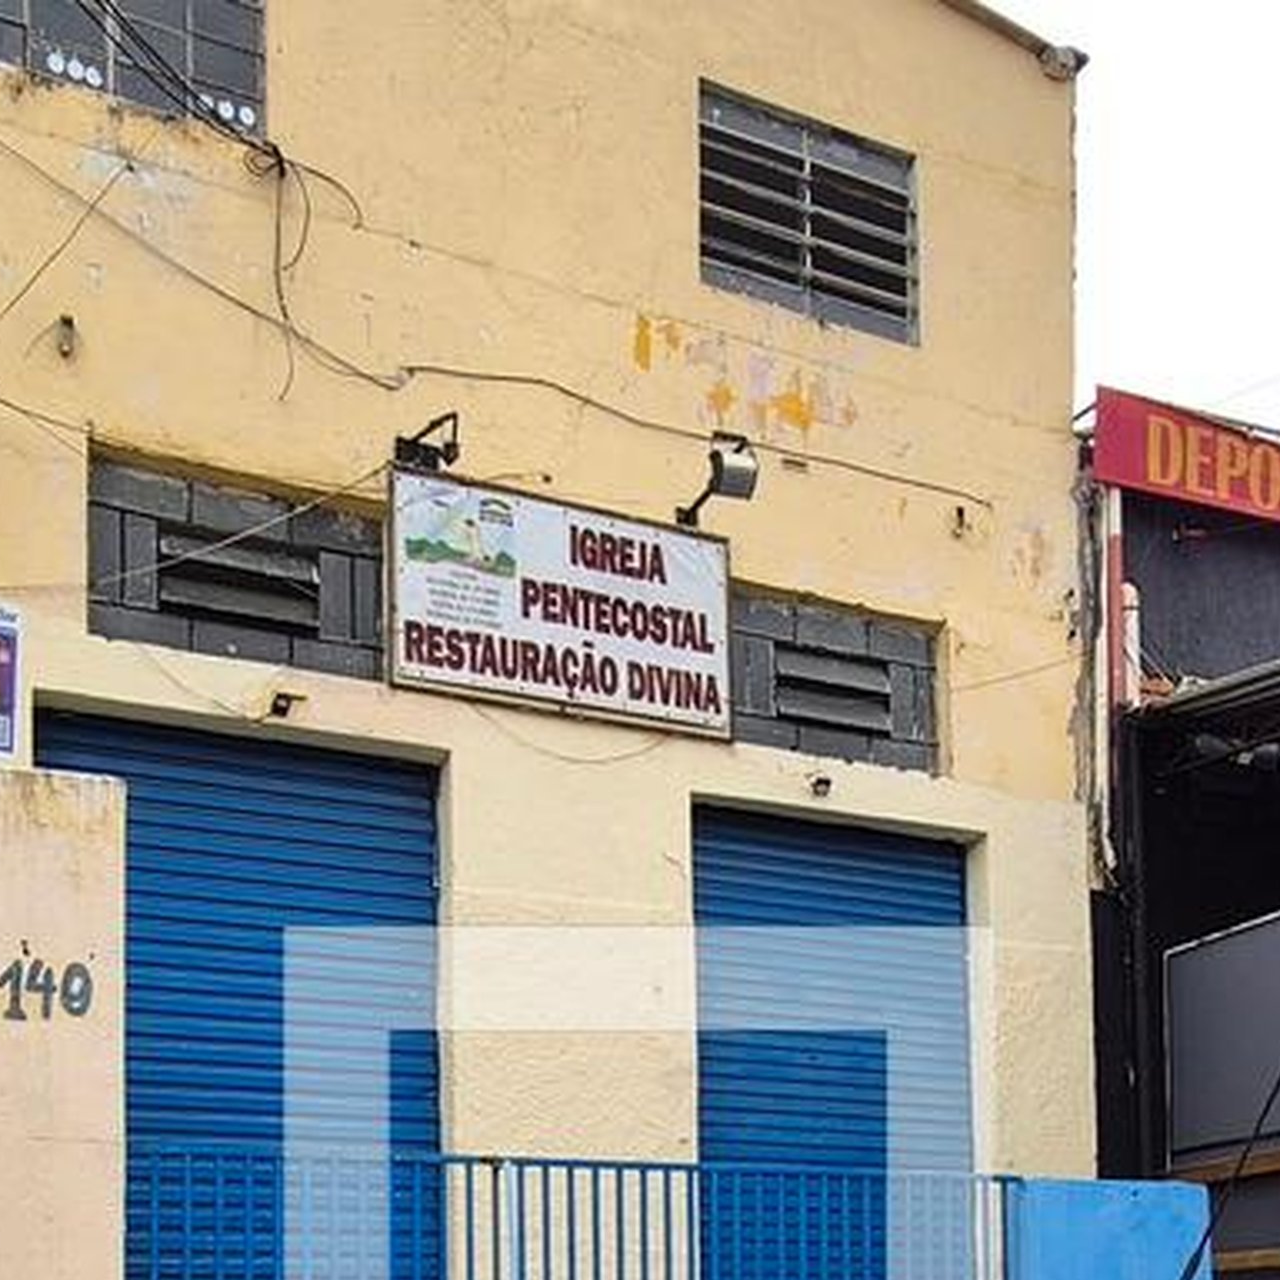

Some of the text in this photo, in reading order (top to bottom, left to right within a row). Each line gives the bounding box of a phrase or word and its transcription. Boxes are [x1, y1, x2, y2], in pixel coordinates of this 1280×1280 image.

[569, 524, 667, 585] IGREJA
[521, 578, 716, 655] PENTECOSTAL
[404, 619, 722, 714] RESTAURAÇÃO DIVINA
